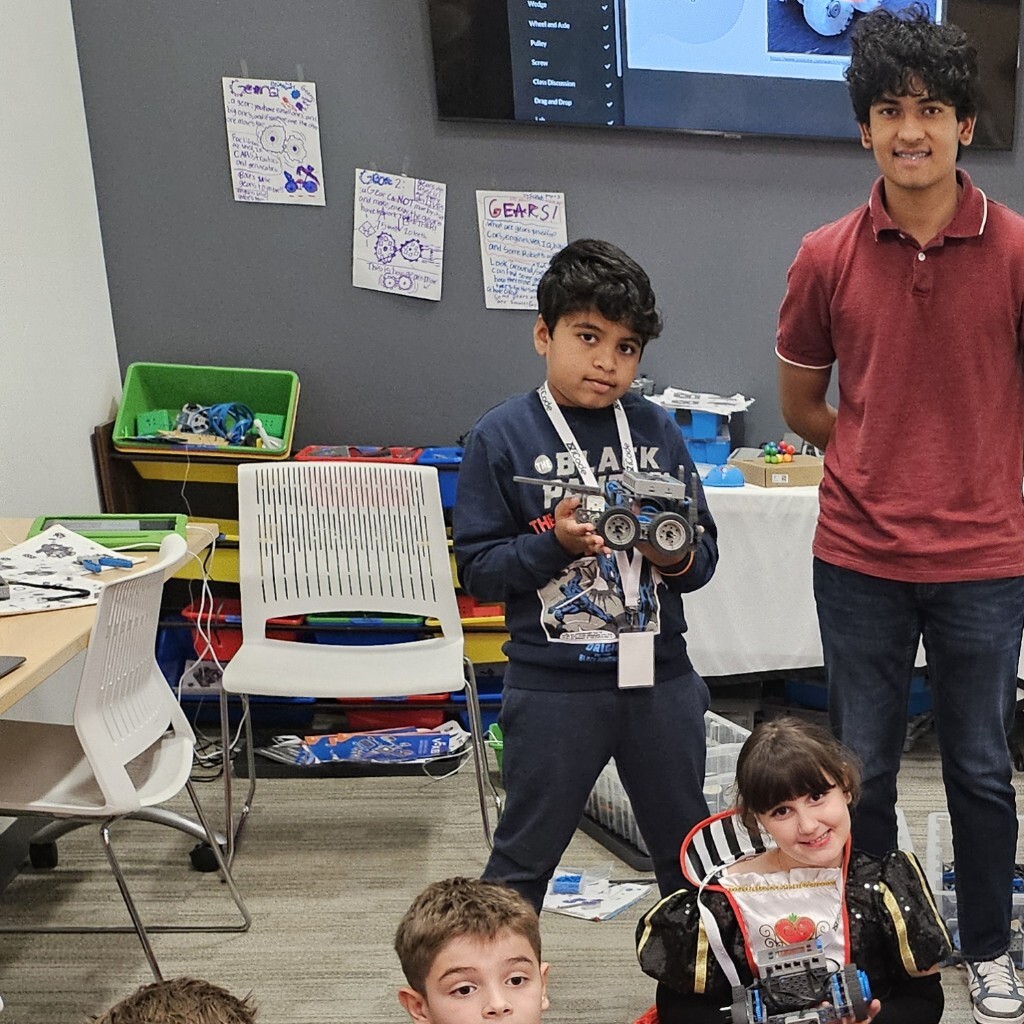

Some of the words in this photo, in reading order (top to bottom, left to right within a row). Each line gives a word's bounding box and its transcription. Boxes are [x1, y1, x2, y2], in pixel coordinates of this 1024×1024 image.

[527, 1, 547, 9] Wedge
[530, 40, 547, 48] Pulley
[534, 97, 547, 105] Drag
[559, 99, 572, 107] Drop
[488, 198, 559, 223] GEARS!
[535, 460, 552, 473] THE
[529, 513, 556, 535] THE
